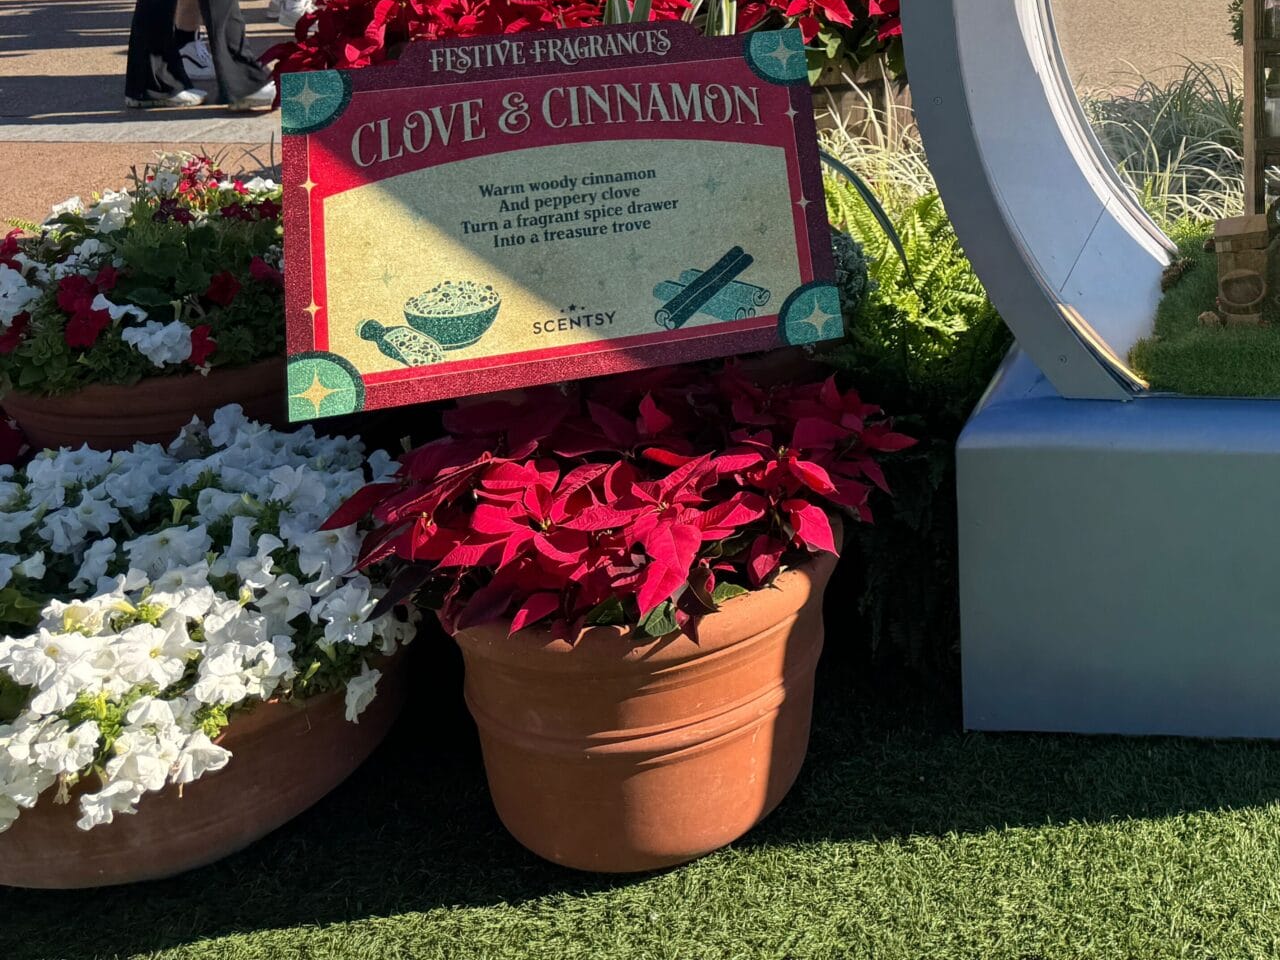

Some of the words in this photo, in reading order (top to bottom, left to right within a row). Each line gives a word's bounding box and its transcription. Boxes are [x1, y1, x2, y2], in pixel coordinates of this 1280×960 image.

[429, 40, 525, 74] FESTIVE
[529, 29, 672, 67] FRAGRANCES
[350, 98, 487, 168] CLOVE
[498, 92, 532, 135] &
[541, 83, 765, 130] CINNAMON
[478, 184, 525, 198] Warm
[529, 175, 578, 190] woody
[581, 169, 656, 186] cinnamon
[498, 197, 530, 213] And
[534, 191, 597, 211] peppery
[601, 185, 641, 200] clove
[461, 220, 499, 234] Turn
[503, 218, 512, 230] a
[516, 208, 580, 227] fragrant
[584, 205, 623, 223] spice
[627, 198, 679, 214] drawer
[493, 233, 526, 248] Into
[530, 233, 540, 244] a
[544, 223, 608, 242] treasure
[612, 219, 652, 234] trove
[533, 311, 616, 334] SCENTSY
